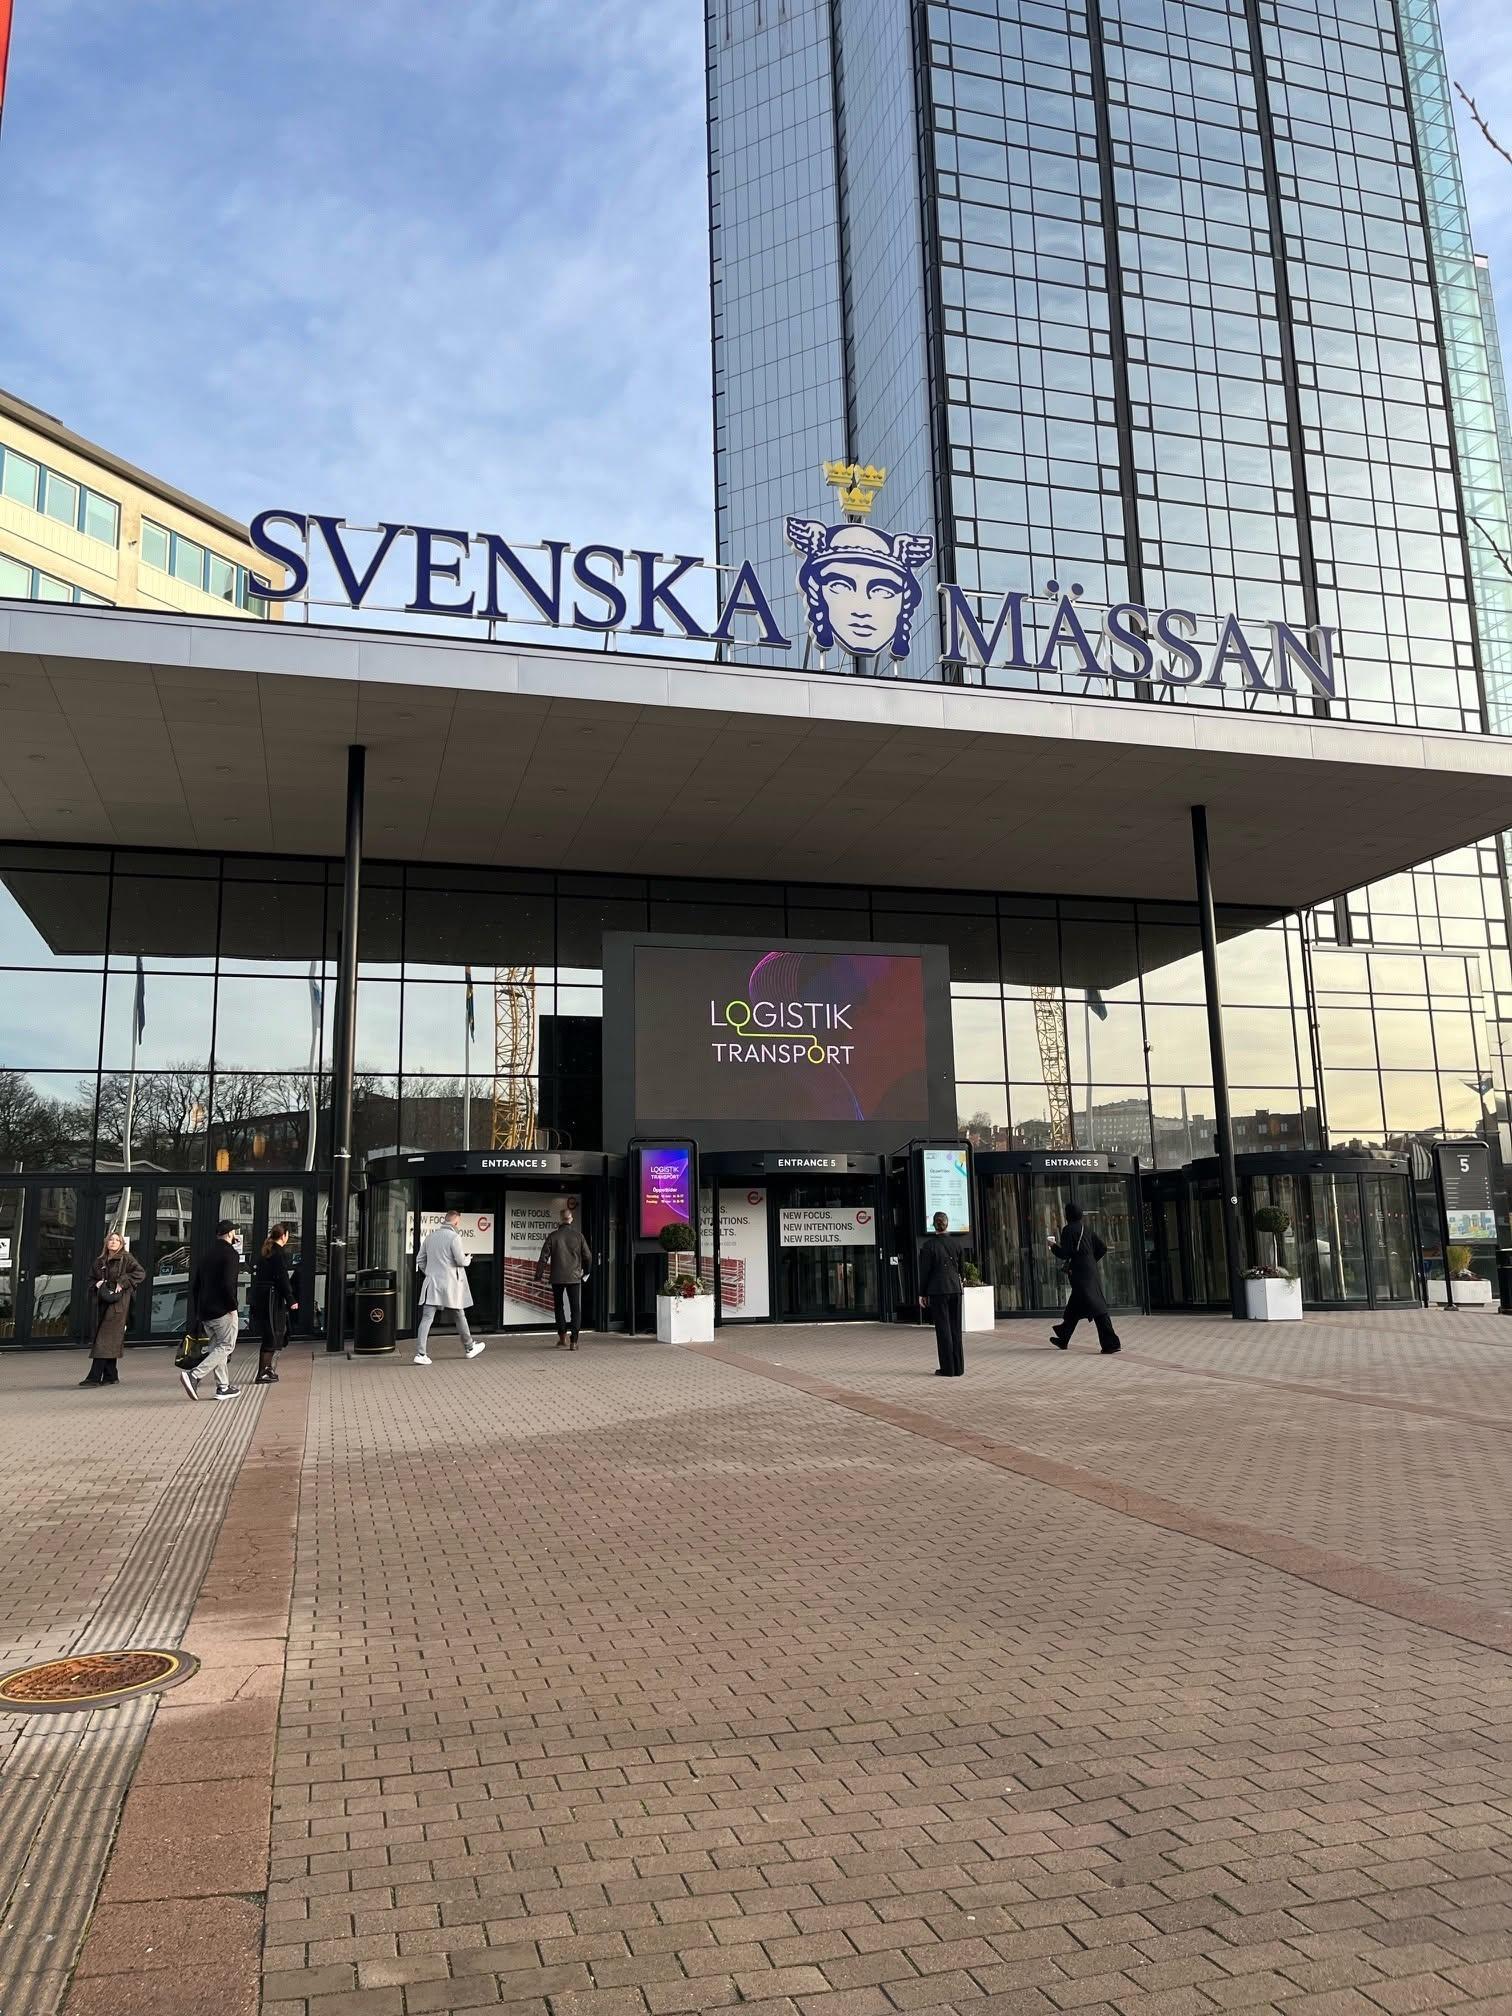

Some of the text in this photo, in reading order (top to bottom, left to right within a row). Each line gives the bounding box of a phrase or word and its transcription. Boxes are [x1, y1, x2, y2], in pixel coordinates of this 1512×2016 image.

[248, 509, 1338, 700] SVENSKA MÄSSAN
[710, 1000, 853, 1030] LOGISTIK
[711, 1043, 855, 1065] TRANSPORT
[481, 1159, 547, 1168] ENTRANCE 5
[778, 1159, 836, 1167] ENTRANCE 5
[1045, 1159, 1099, 1167] ENTRANCE 5
[1459, 1158, 1470, 1173] 5
[650, 1166, 680, 1174] LOGISTIK
[511, 1209, 526, 1217] NEW
[783, 1211, 833, 1219] NEW FOCUS.
[511, 1221, 560, 1229] NEW INTENTIO
[783, 1222, 855, 1231] NEW INTENTIONS.
[511, 1232, 526, 1240] NEW
[784, 1234, 842, 1243] NEW RESULTS.
